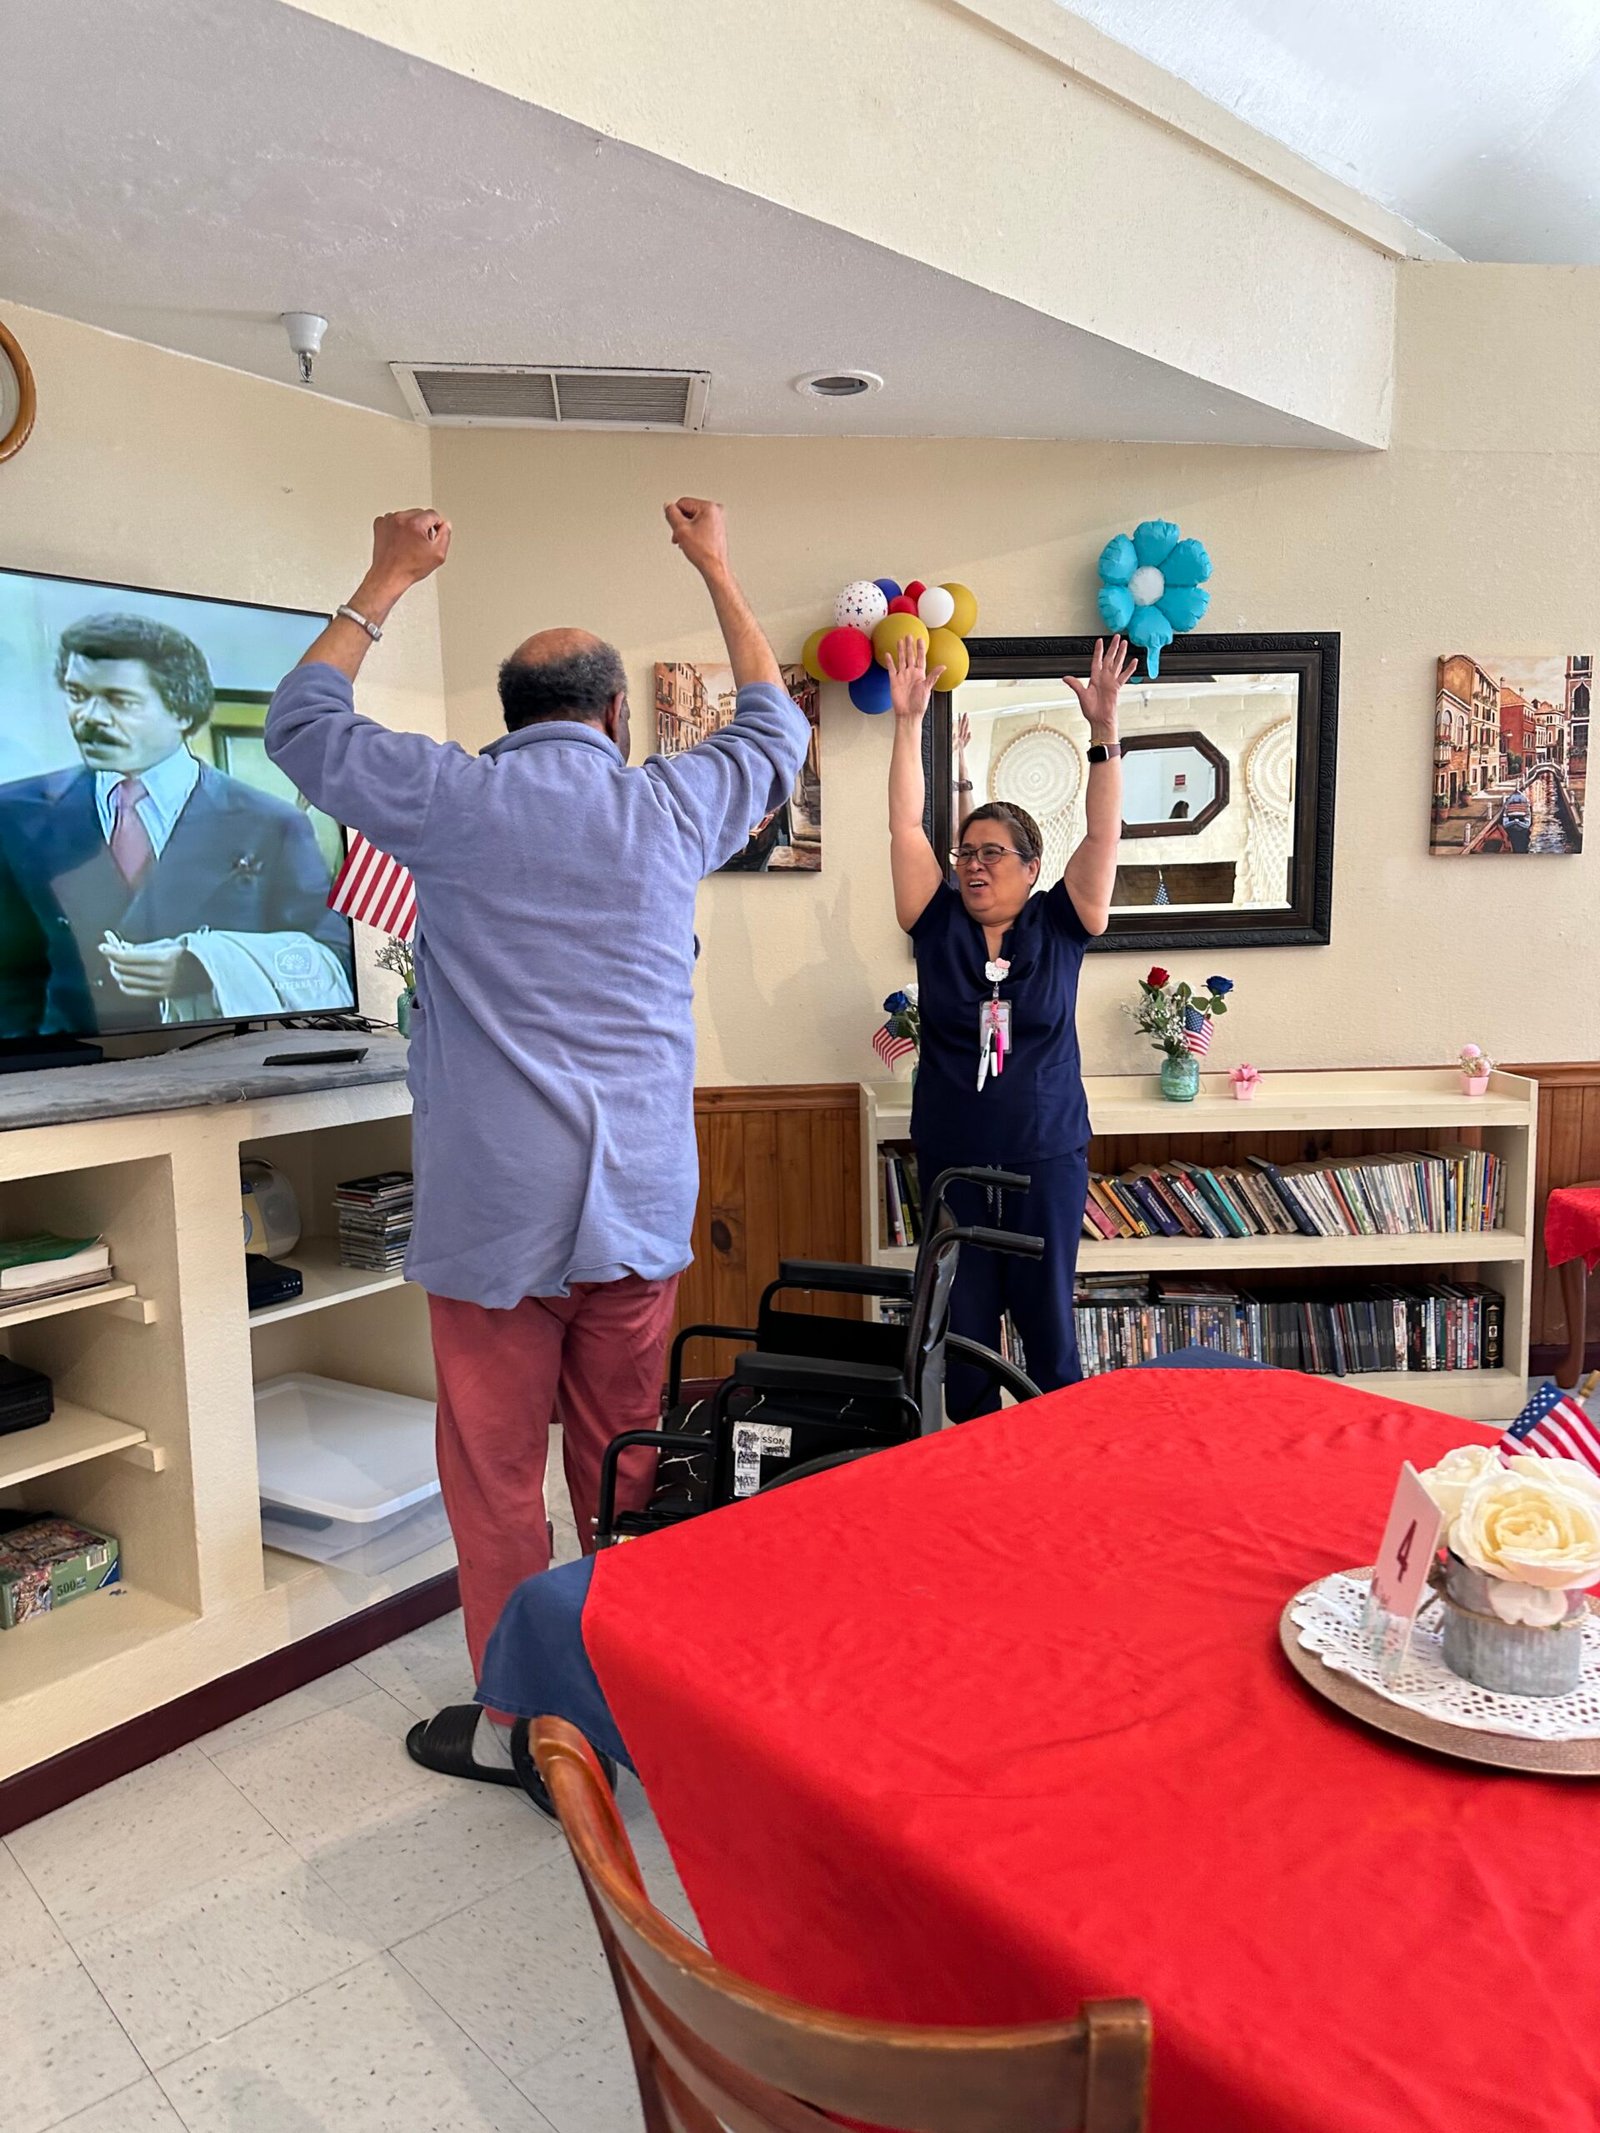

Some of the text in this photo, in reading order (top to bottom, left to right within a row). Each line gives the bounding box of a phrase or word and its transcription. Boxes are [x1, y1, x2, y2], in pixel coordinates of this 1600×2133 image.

[274, 980, 311, 991] ANTENNA
[762, 1436, 785, 1445] SSON
[1396, 1519, 1418, 1584] 4
[57, 1580, 76, 1597] 500
